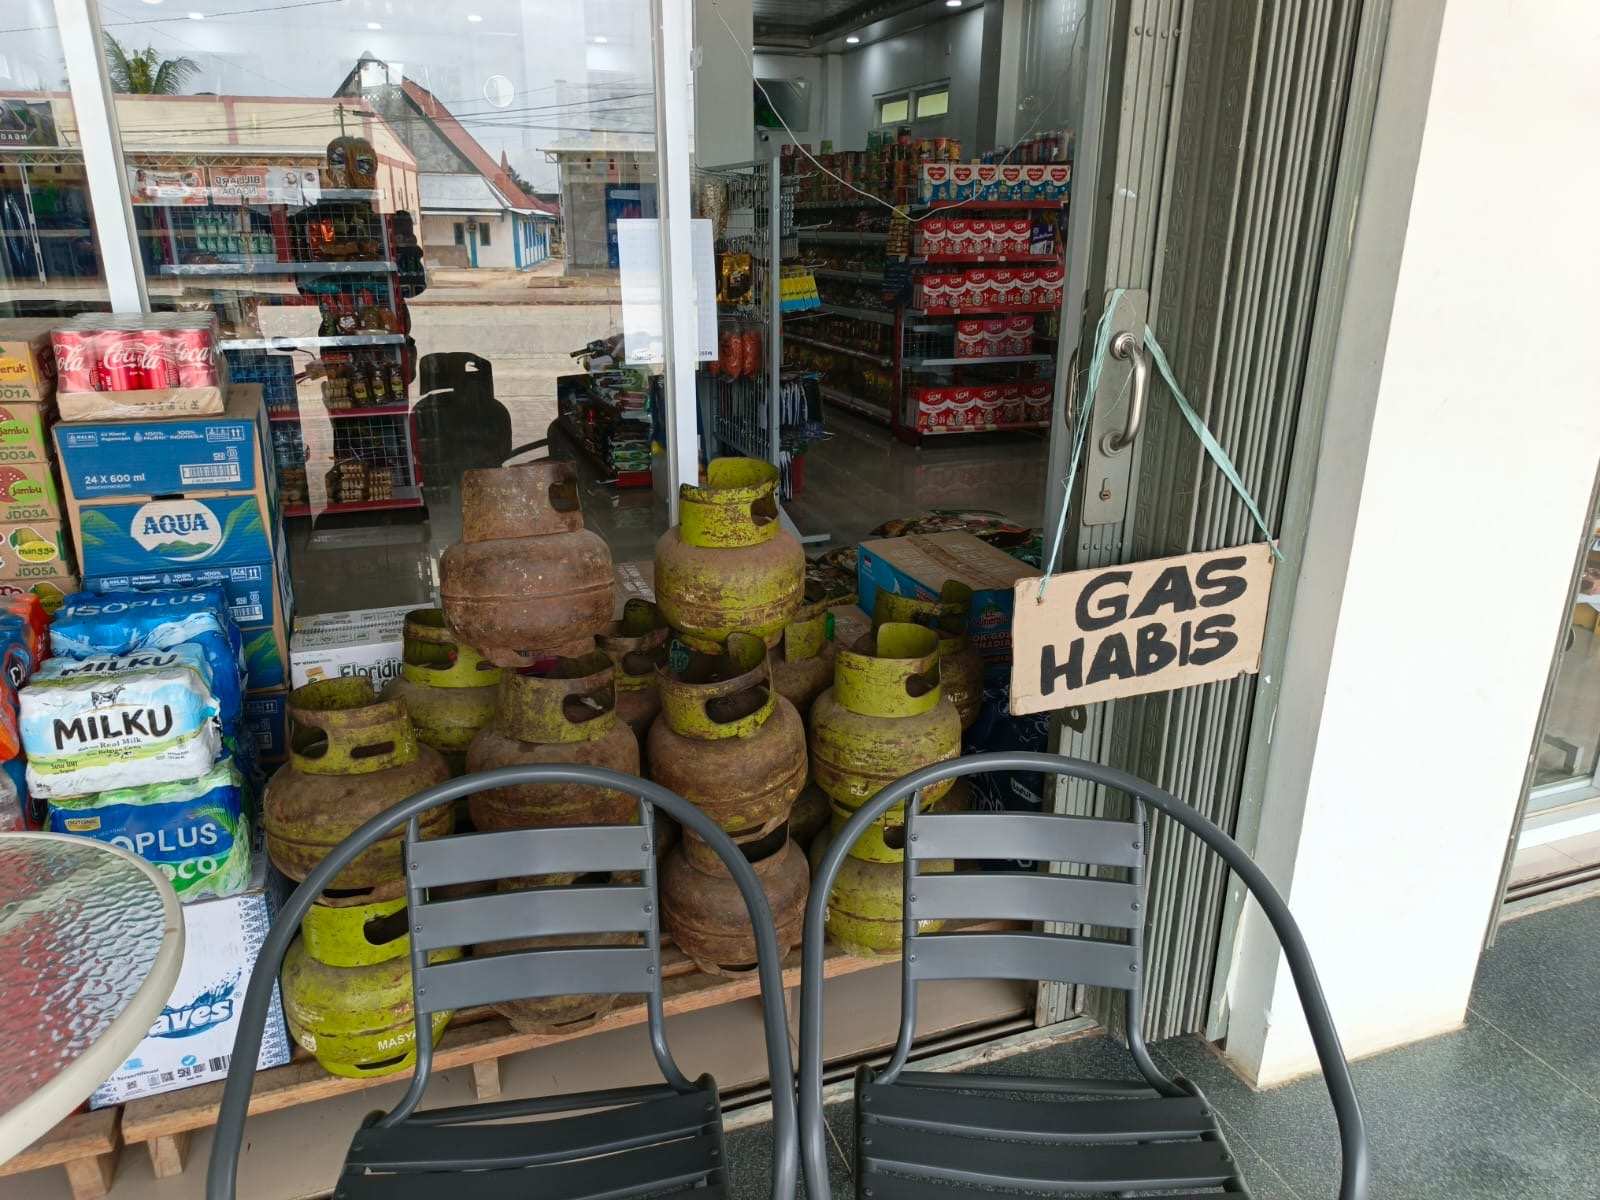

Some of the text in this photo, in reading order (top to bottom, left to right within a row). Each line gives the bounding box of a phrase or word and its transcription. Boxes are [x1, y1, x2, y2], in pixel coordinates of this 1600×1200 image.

[0, 363, 27, 374] eruk
[84, 475, 97, 485] 24
[110, 473, 131, 483] 600
[133, 472, 146, 482] ml
[143, 512, 210, 536] AQUA
[1075, 556, 1248, 632] GAS
[60, 654, 178, 675] MILKU
[1040, 613, 1239, 696] HABIS
[53, 704, 174, 751] MILKU
[108, 822, 218, 856] OPLUS
[147, 998, 234, 1037] aves
